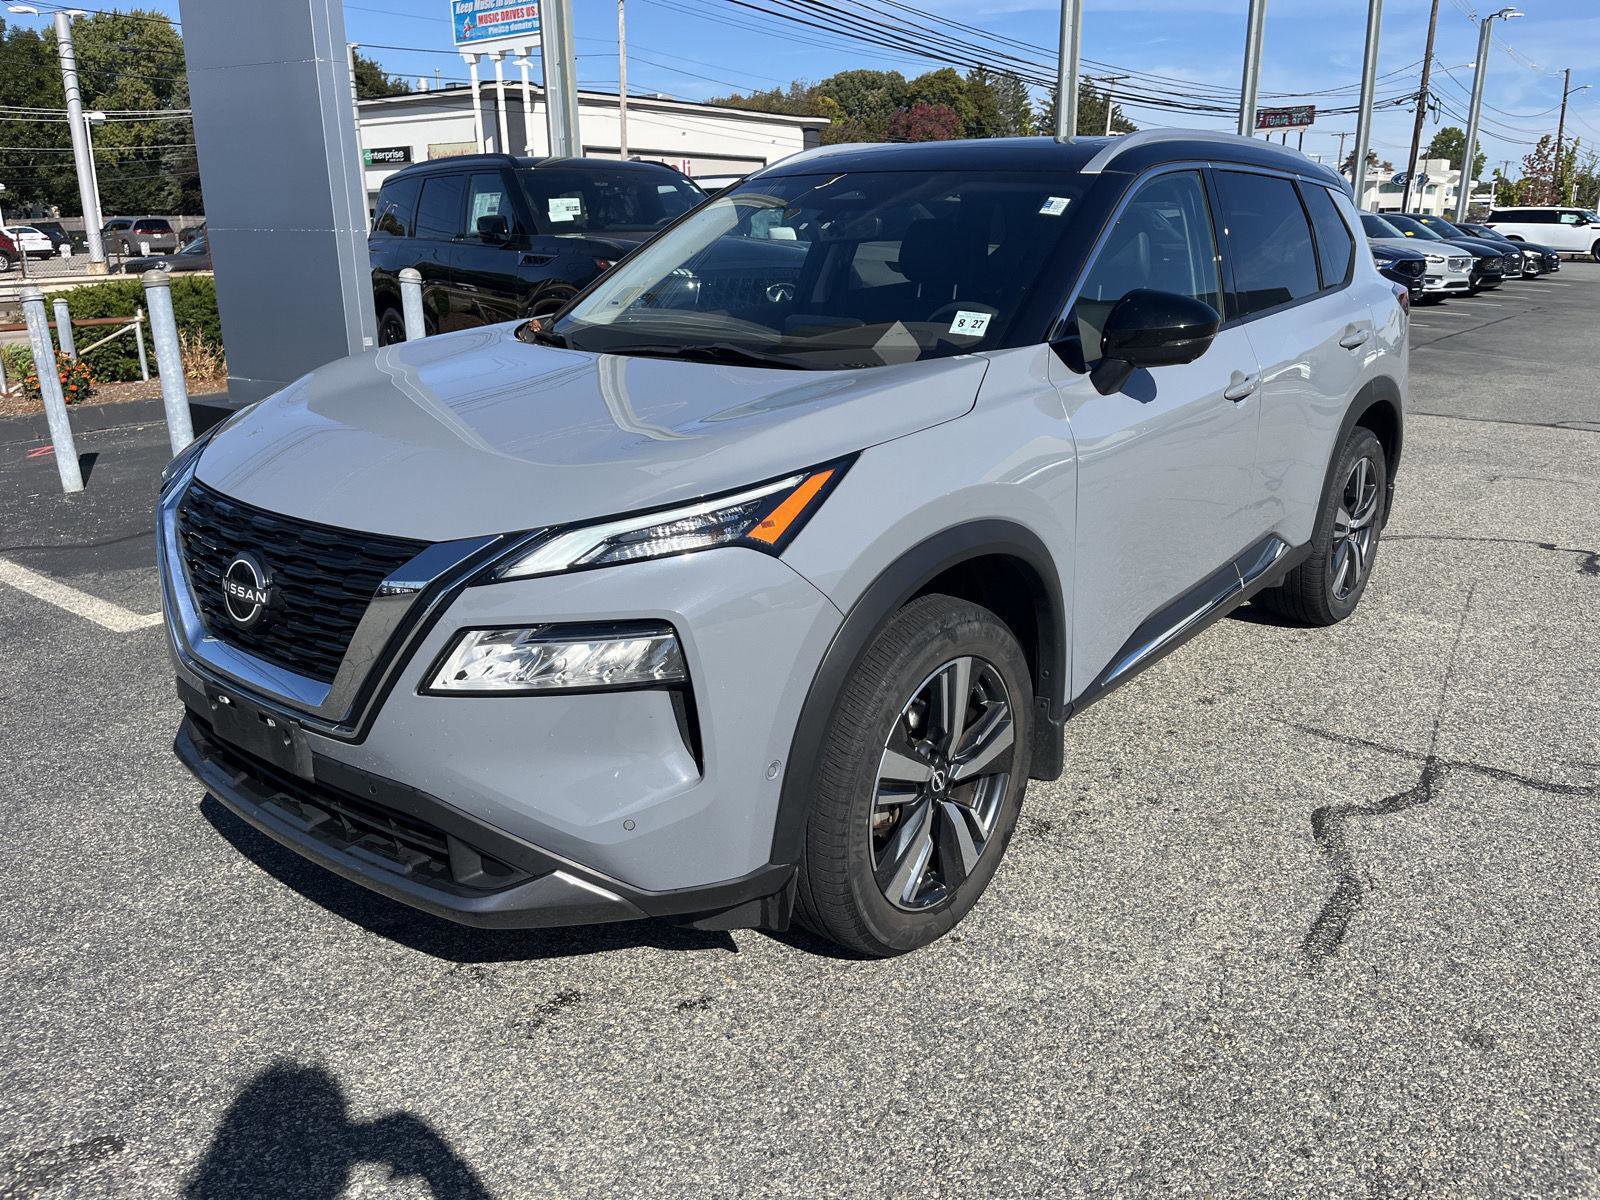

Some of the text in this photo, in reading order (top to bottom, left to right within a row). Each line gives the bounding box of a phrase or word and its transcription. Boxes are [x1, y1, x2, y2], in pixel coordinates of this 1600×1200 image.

[456, 1, 474, 15] Keep
[477, 13, 500, 25] MUSIC
[500, 7, 525, 23] DRIVES
[488, 26, 510, 35] Please
[510, 22, 532, 31] donate
[363, 149, 405, 161] enterprise
[958, 319, 984, 329] 8 27
[222, 577, 267, 604] NISSAN
